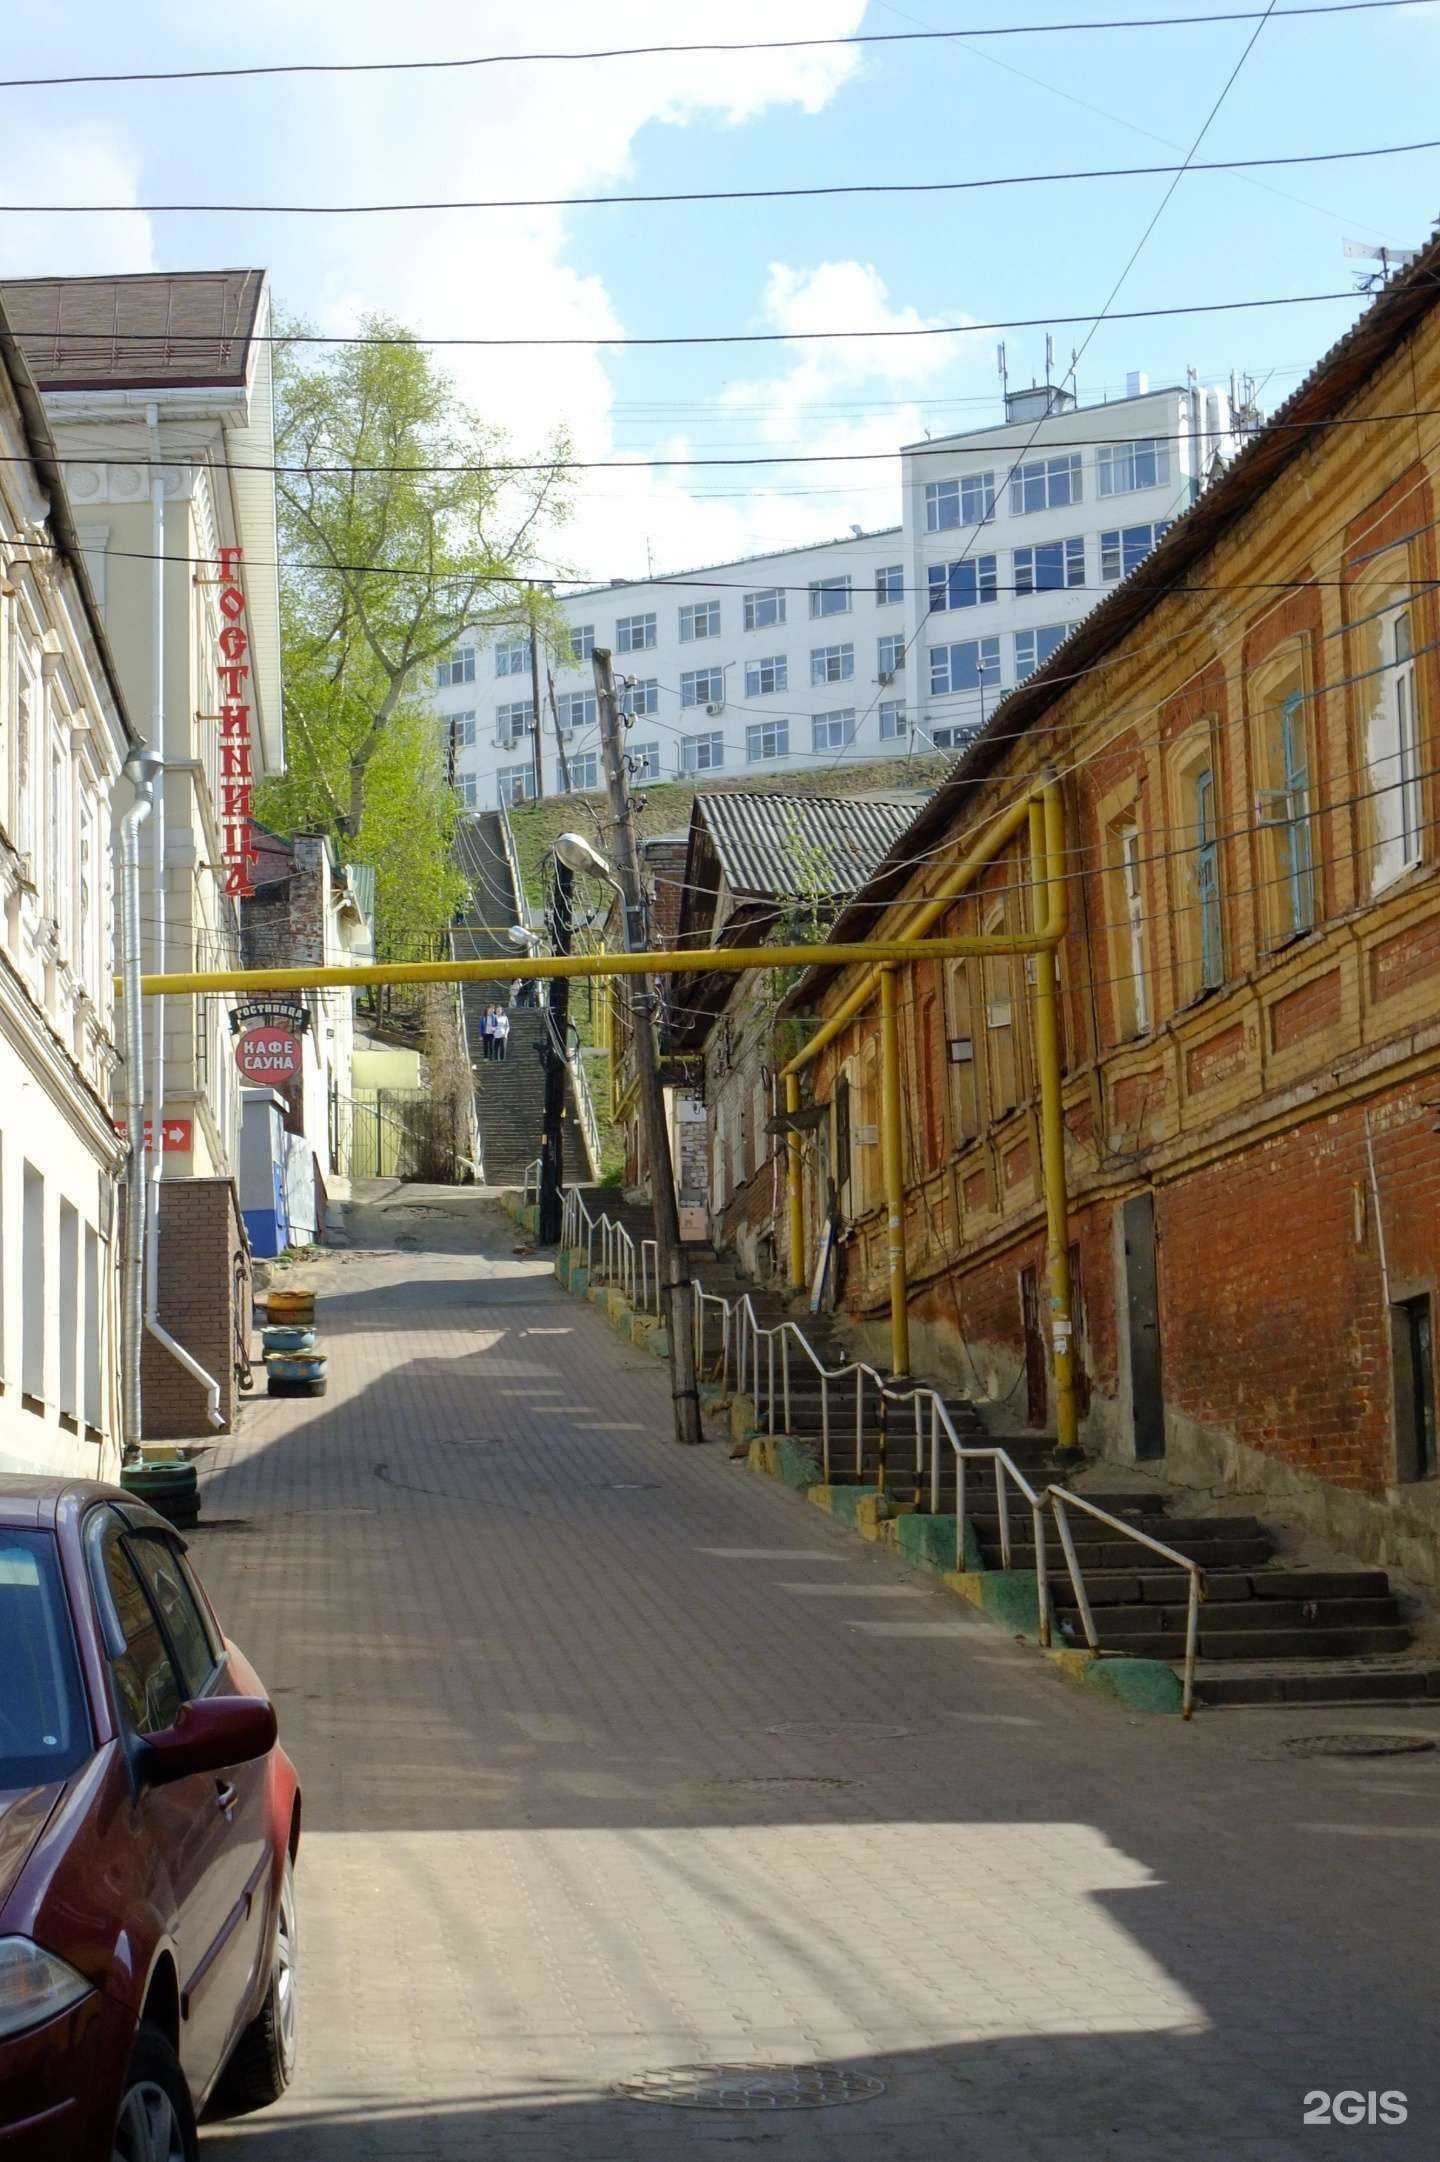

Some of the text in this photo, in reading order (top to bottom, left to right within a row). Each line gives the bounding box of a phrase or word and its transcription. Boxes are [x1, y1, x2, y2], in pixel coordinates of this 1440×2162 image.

[217, 547, 258, 896] ГОСТИНИЦА
[235, 1004, 303, 1018] ГОСТИНИЦА
[244, 1041, 294, 1054] КАФЕ
[244, 1056, 294, 1069] САУНА
